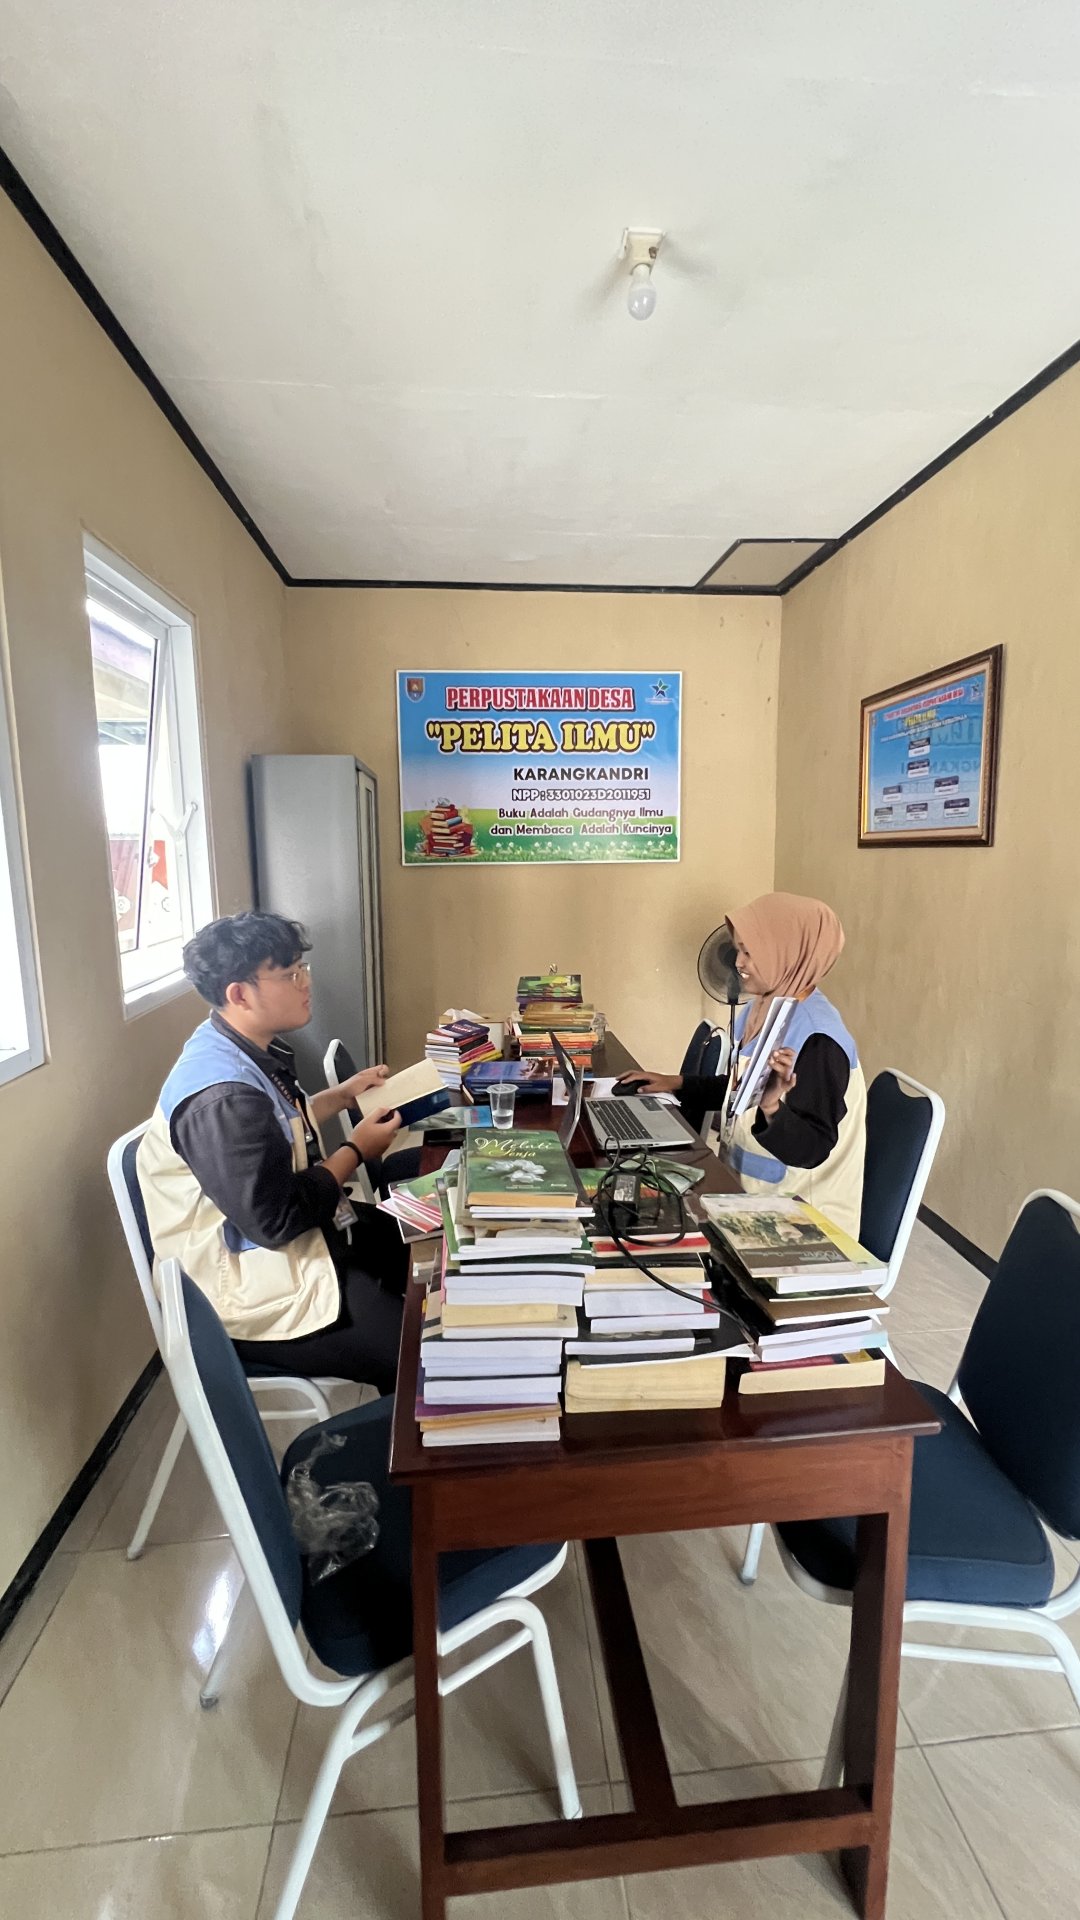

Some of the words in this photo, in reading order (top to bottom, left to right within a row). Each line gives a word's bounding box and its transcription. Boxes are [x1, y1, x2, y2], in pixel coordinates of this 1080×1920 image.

[446, 687, 586, 710] PERPUSTAKAAN
[587, 687, 635, 711] DESA
[426, 720, 558, 752] "PELITA
[560, 720, 655, 752] ILMU"
[513, 767, 649, 781] KARANGKANDRI
[547, 788, 651, 801] 3301023D2011951
[498, 807, 526, 818] Buku
[530, 807, 569, 818] Adalah
[572, 807, 636, 822] Gudangnya
[639, 807, 664, 817] Ilmu
[490, 825, 513, 835] dan
[516, 824, 573, 835] Membaca
[580, 823, 619, 834] Adalah
[622, 823, 672, 836] Kuncinya
[474, 1137, 555, 1151] Melati
